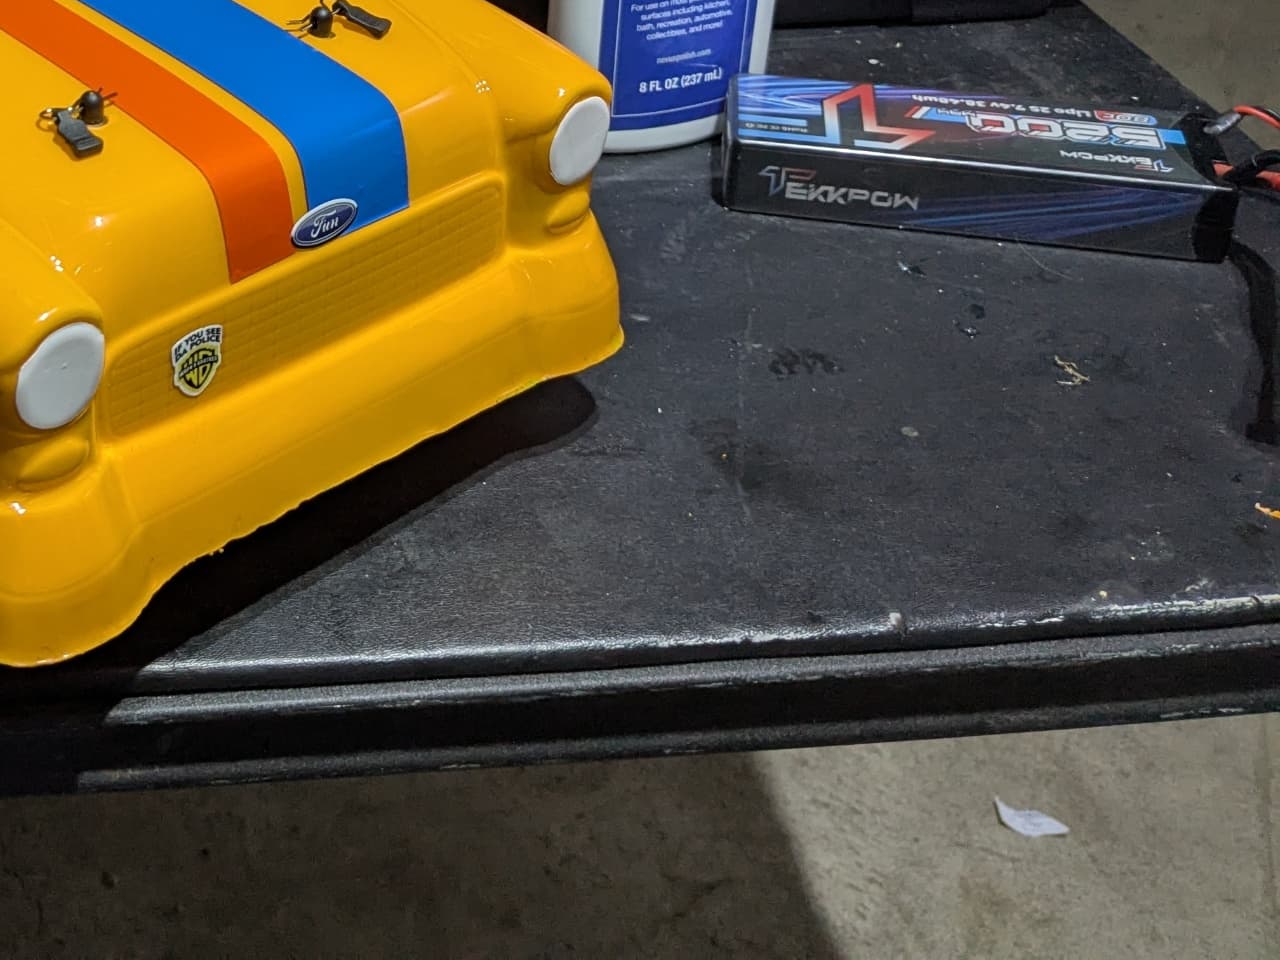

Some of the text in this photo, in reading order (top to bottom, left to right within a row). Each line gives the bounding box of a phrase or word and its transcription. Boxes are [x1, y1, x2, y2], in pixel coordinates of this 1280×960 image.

[631, 3, 644, 13] For
[645, 2, 658, 11] use
[660, 0, 669, 8] on
[640, 0, 731, 22] surfaces including kitchen,
[636, 9, 733, 33] bath, recreation, automotive,
[646, 27, 688, 41] collectibles,
[688, 24, 702, 34] and
[639, 66, 724, 93] 8 FL OZ (237 mL)
[966, 112, 1166, 150] 5200
[758, 164, 919, 211] TEKKPOW
[183, 330, 204, 346] YOU
[205, 327, 222, 335] SEE
[190, 335, 220, 350] POLICE
